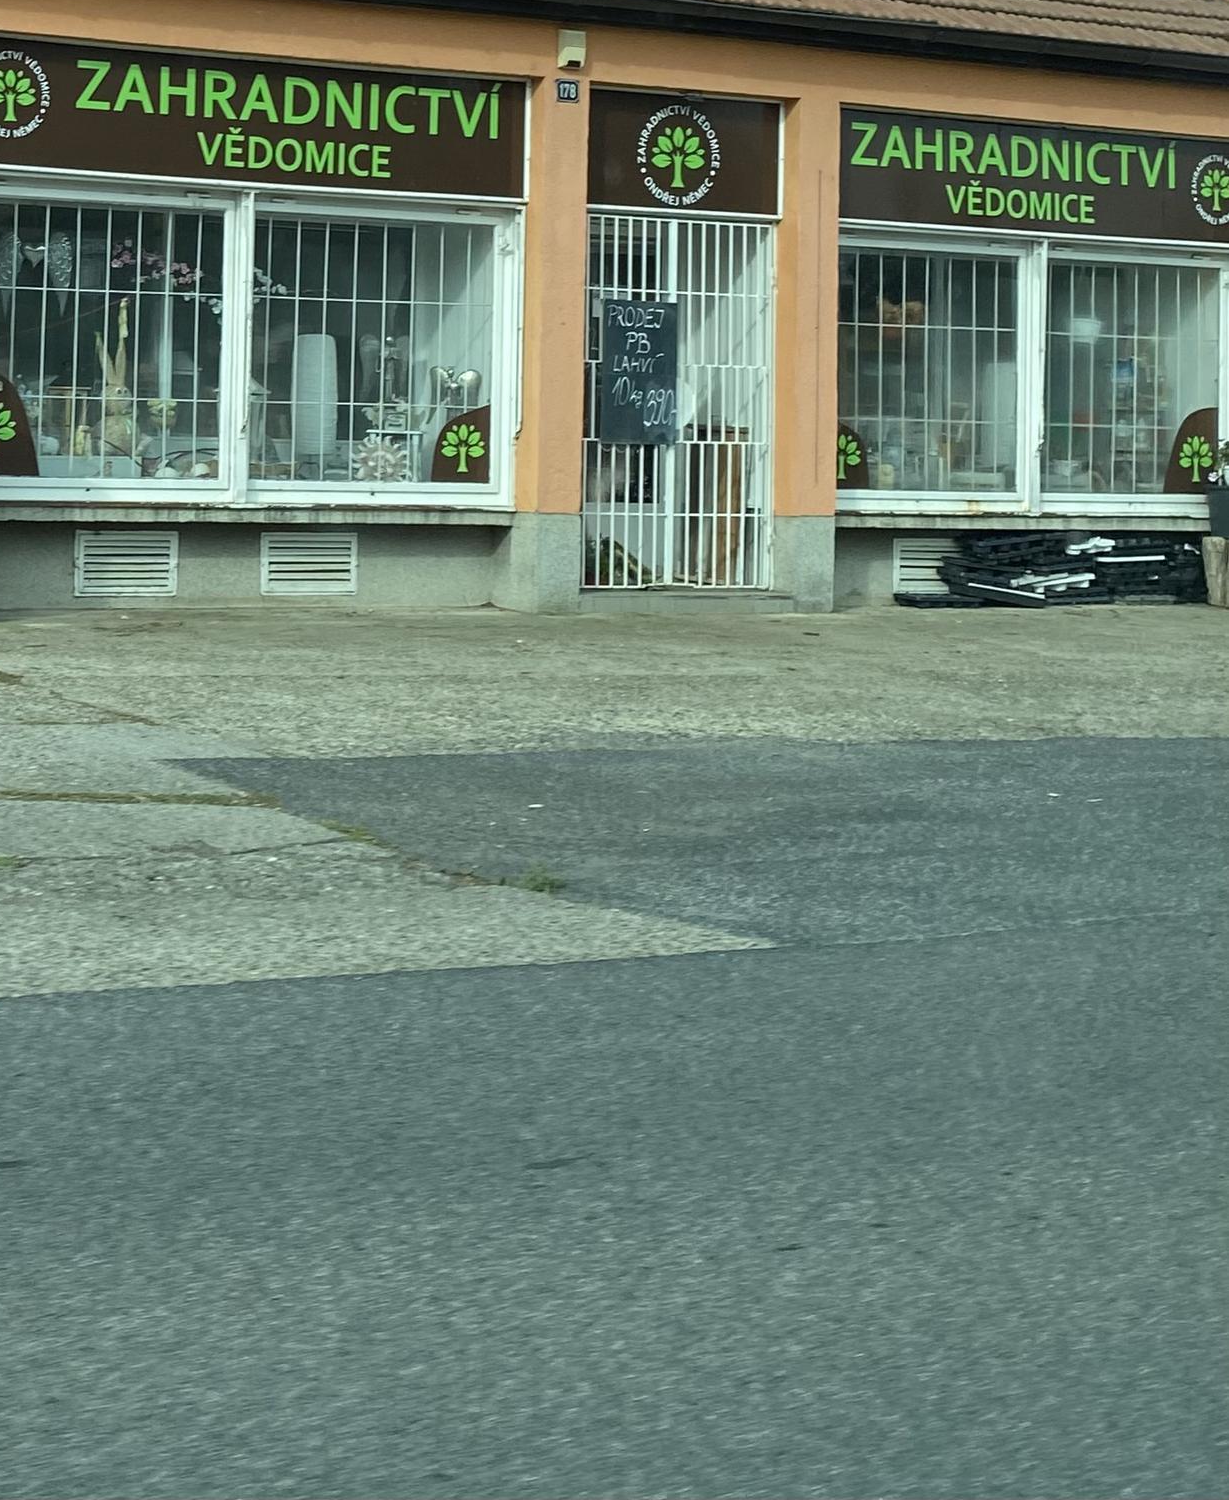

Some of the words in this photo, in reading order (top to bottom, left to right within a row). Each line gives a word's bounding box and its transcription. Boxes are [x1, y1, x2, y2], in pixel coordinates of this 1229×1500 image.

[75, 60, 503, 140] ZAHRADNICTVÍ
[559, 83, 577, 99] 178
[196, 126, 392, 178] VĚDOMICE
[637, 105, 691, 164] ZAHRADNICTVÍ
[692, 110, 720, 169] VĚDOMICE
[851, 122, 1176, 189] ZAHRADNICTVÍ
[644, 176, 679, 206] ONDŘEJ
[682, 178, 714, 206] NĚMEC
[945, 179, 1096, 224] VĚDOMICE
[607, 304, 665, 328] PRODEJ
[625, 331, 651, 354] PB
